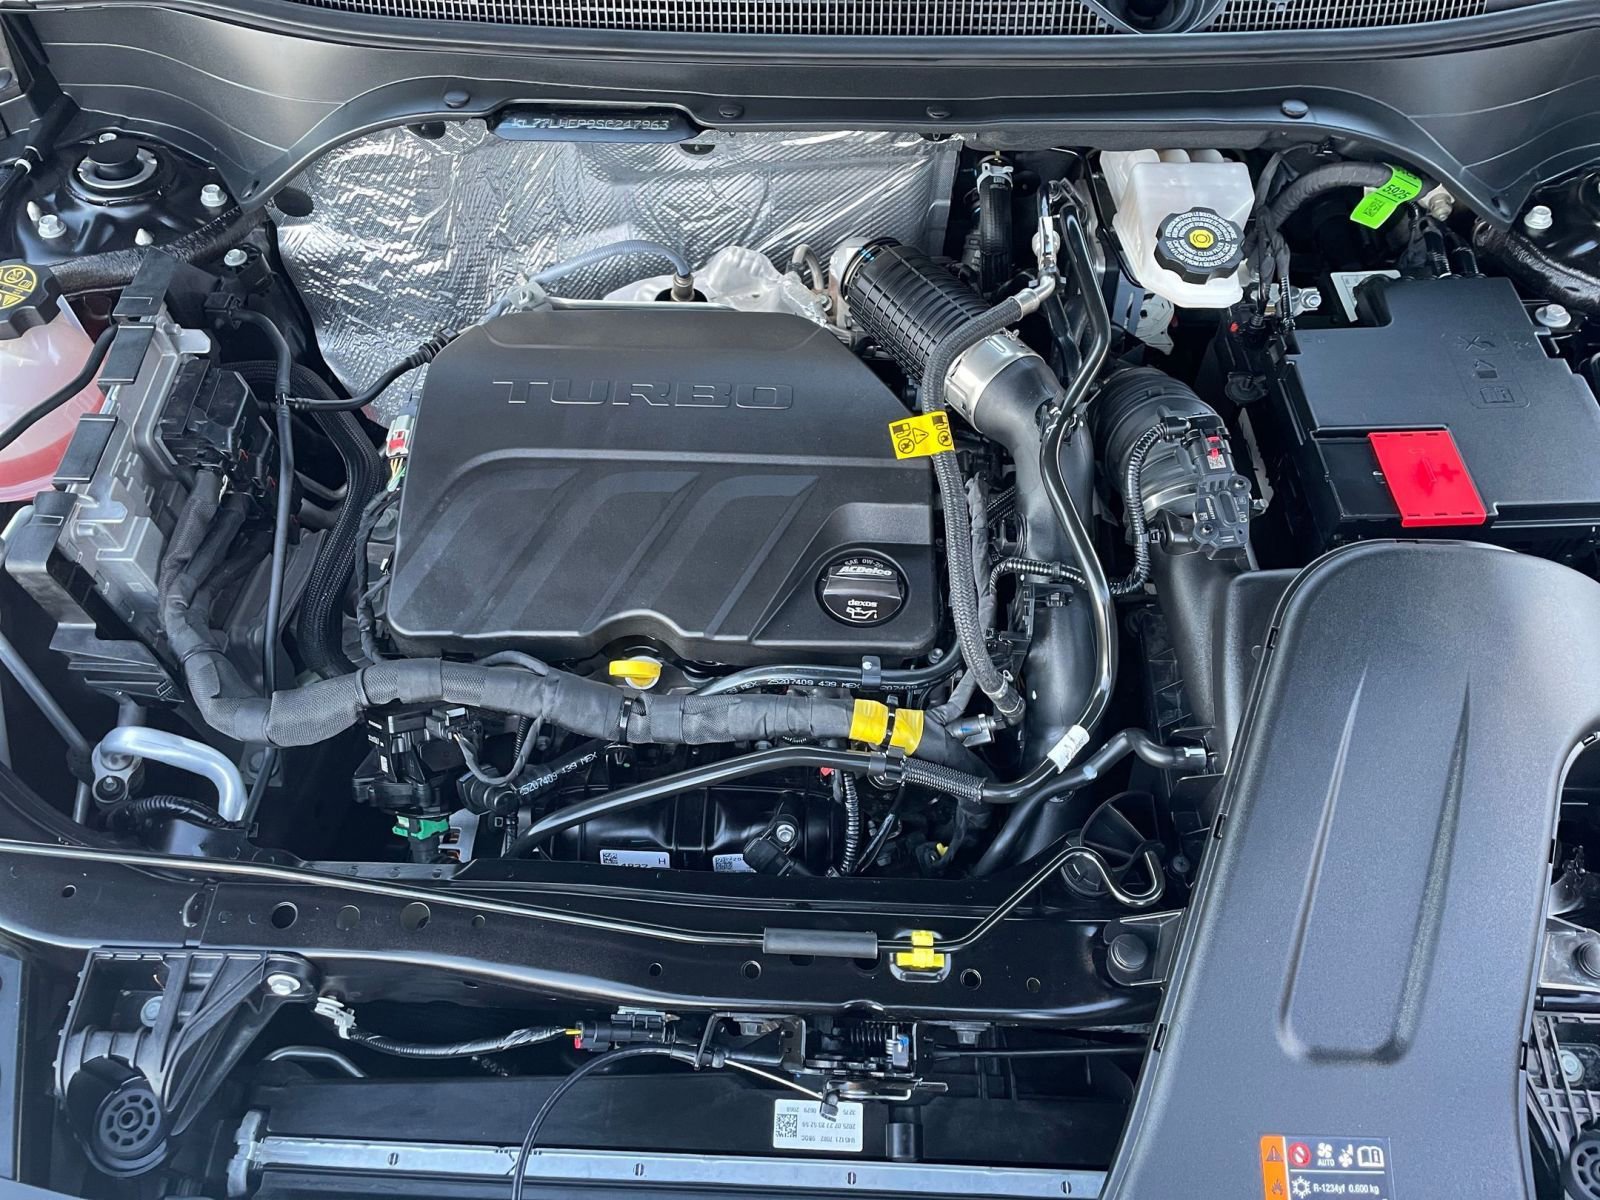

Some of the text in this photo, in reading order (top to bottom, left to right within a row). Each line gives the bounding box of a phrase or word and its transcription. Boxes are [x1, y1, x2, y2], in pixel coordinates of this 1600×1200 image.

[492, 379, 794, 410] TURBO
[844, 558, 859, 568] SAE
[836, 566, 893, 577] ACDelco
[847, 598, 879, 608] dexos
[658, 857, 666, 865] H
[1318, 1159, 1335, 1167] AUTO
[1313, 1184, 1345, 1194] R-1234yf
[1369, 1185, 1380, 1195] kg
